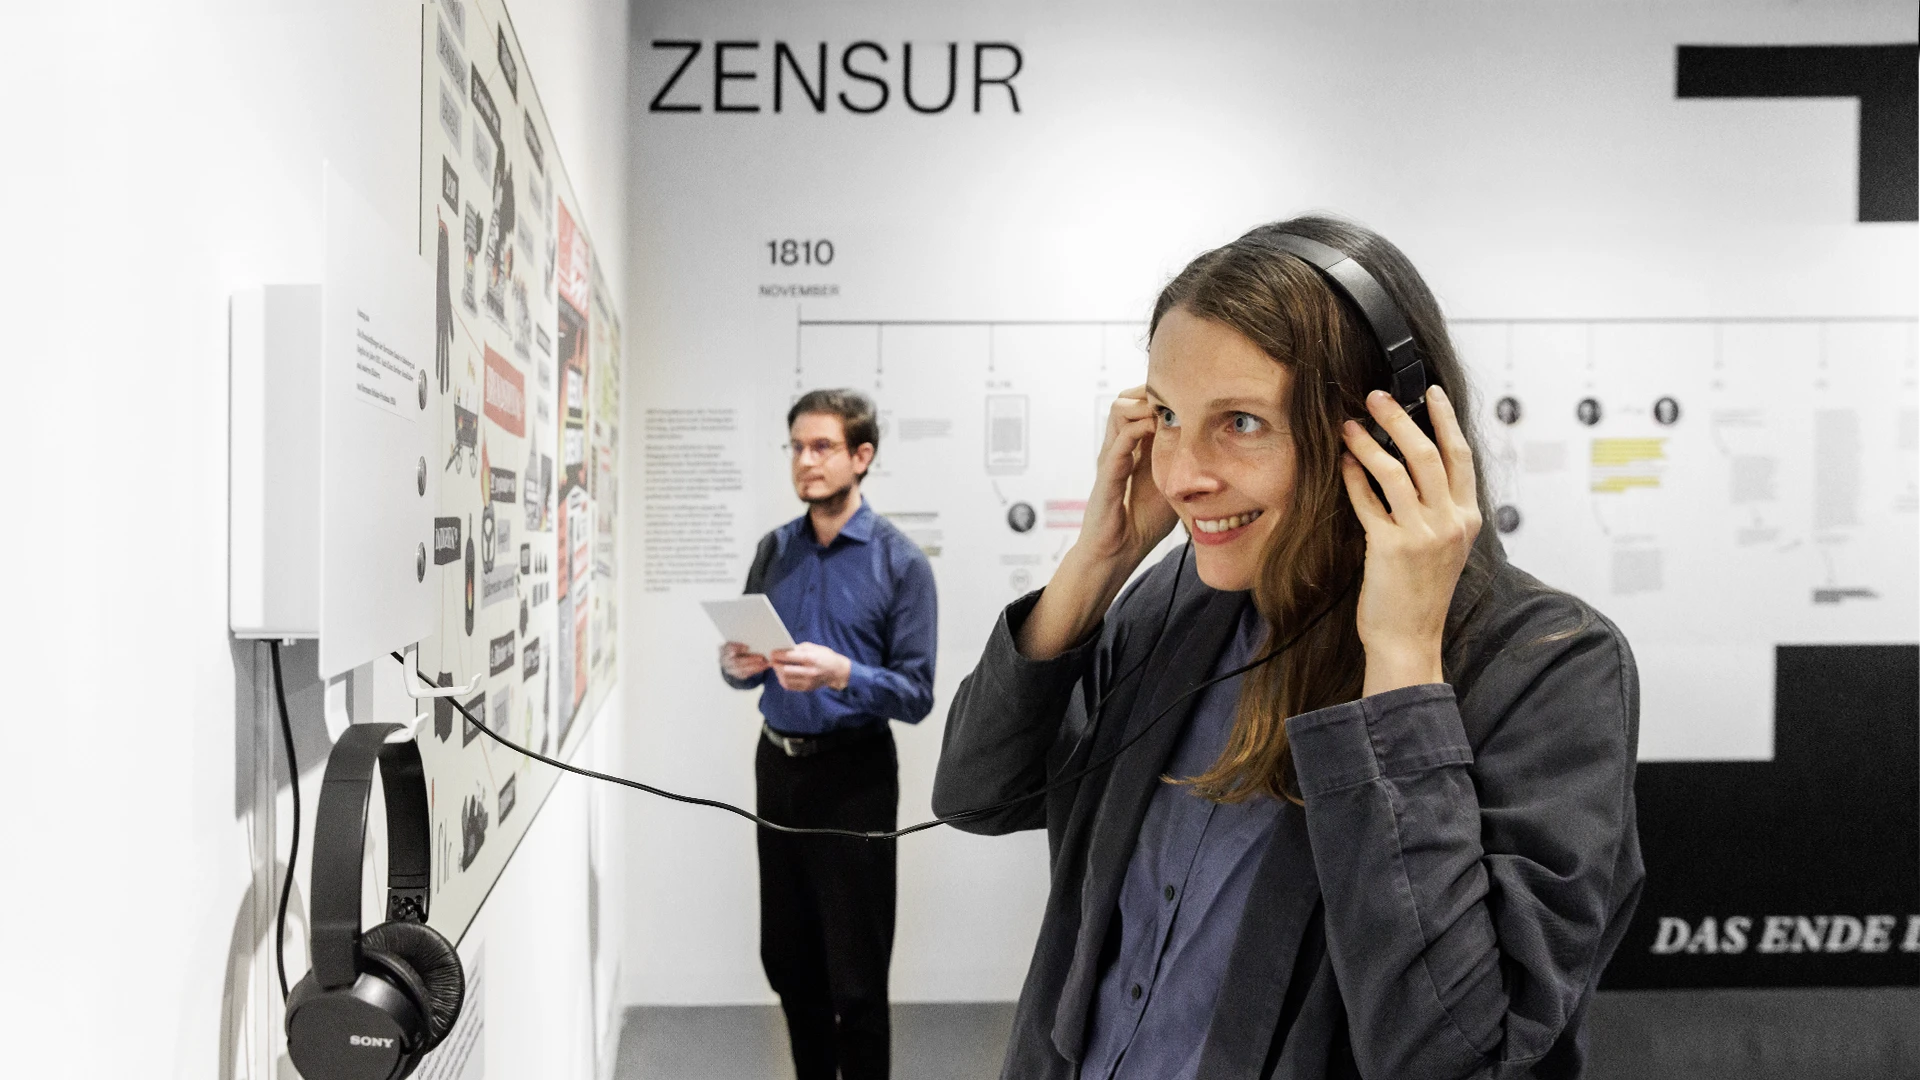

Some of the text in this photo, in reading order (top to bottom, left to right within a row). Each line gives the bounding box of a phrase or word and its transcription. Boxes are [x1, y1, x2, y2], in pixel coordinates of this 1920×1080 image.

[649, 41, 1024, 114] ZENSUR
[766, 239, 834, 266] 1810
[758, 284, 840, 297] NOVEMBER
[1652, 916, 1752, 954] DAS
[1757, 915, 1897, 953] ENDE
[349, 1035, 394, 1048] SONY
